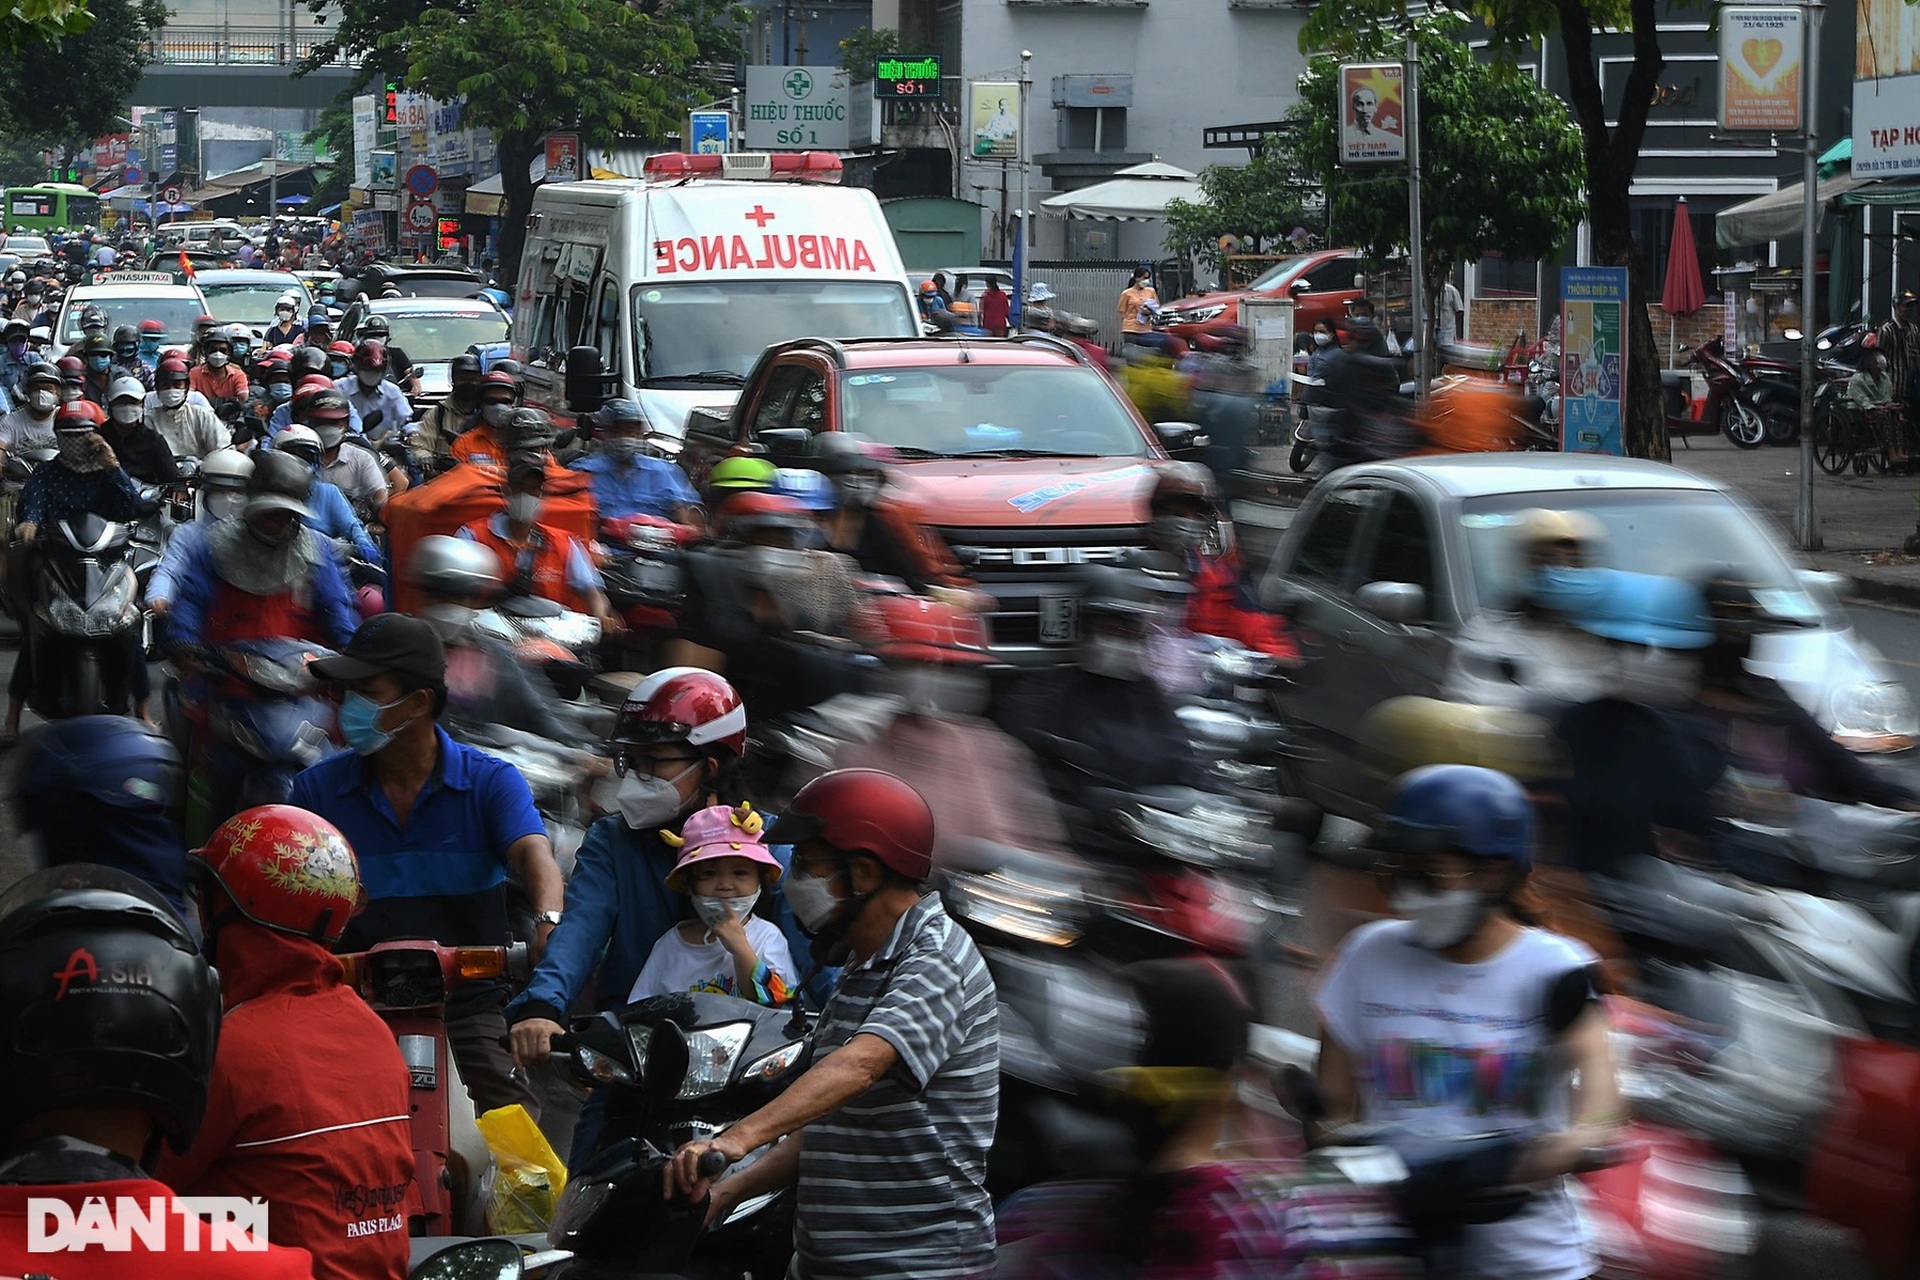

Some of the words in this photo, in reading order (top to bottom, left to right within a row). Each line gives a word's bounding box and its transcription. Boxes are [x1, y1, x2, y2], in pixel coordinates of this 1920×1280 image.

[879, 60, 903, 82] HIỆU
[904, 60, 938, 79] THUỐC
[896, 80, 915, 94] SỐ
[917, 84, 924, 93] 1
[409, 104, 425, 125] 8A
[750, 100, 788, 124] HIỆU
[793, 98, 845, 121] THUỐC
[776, 124, 804, 144] SỐ
[809, 131, 818, 144] 1
[1870, 128, 1899, 152] TẠP
[702, 144, 719, 154] 30/4
[1367, 142, 1387, 150] NAM
[347, 1220, 377, 1238] PARIS
